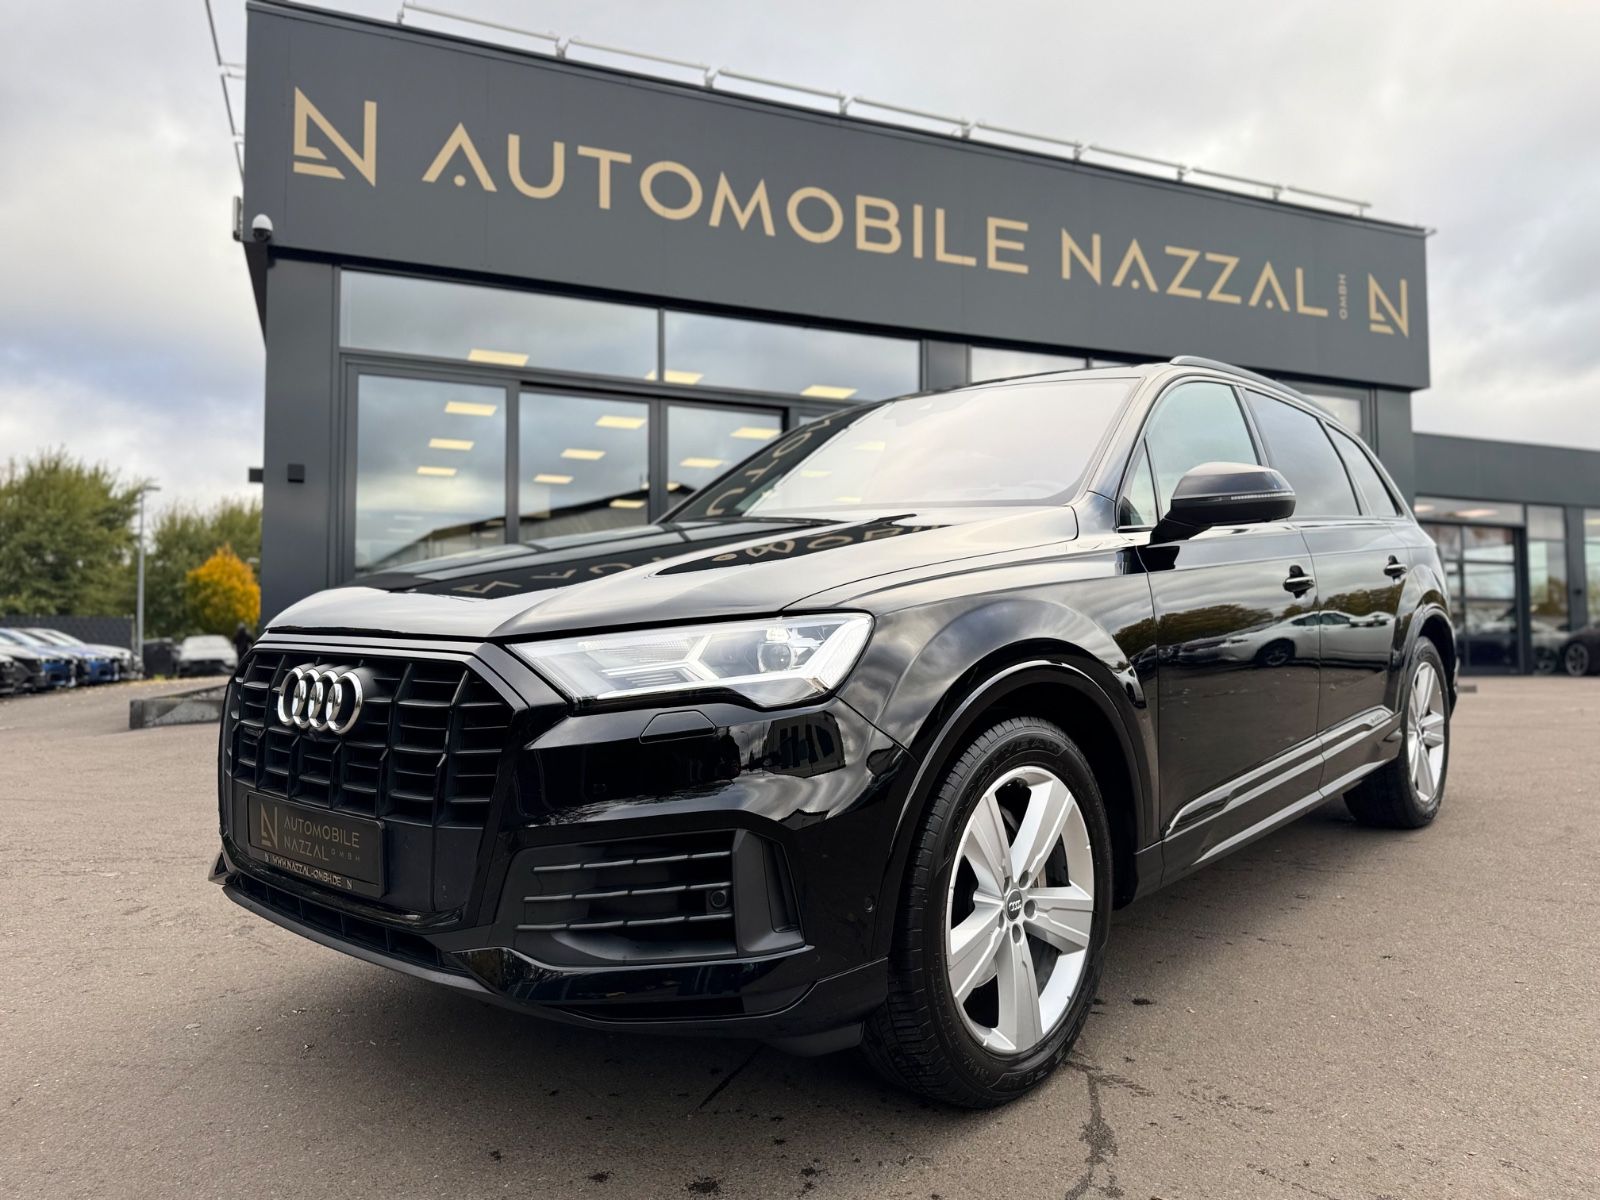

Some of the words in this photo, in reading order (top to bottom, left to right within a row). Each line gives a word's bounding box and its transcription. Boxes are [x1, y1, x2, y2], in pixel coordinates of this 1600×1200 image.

[422, 122, 1029, 275] AUTOMOBILE
[1060, 228, 1329, 318] NAZZAL
[283, 815, 360, 849] AUTOMOBILE
[283, 836, 330, 861] NAZZAL
